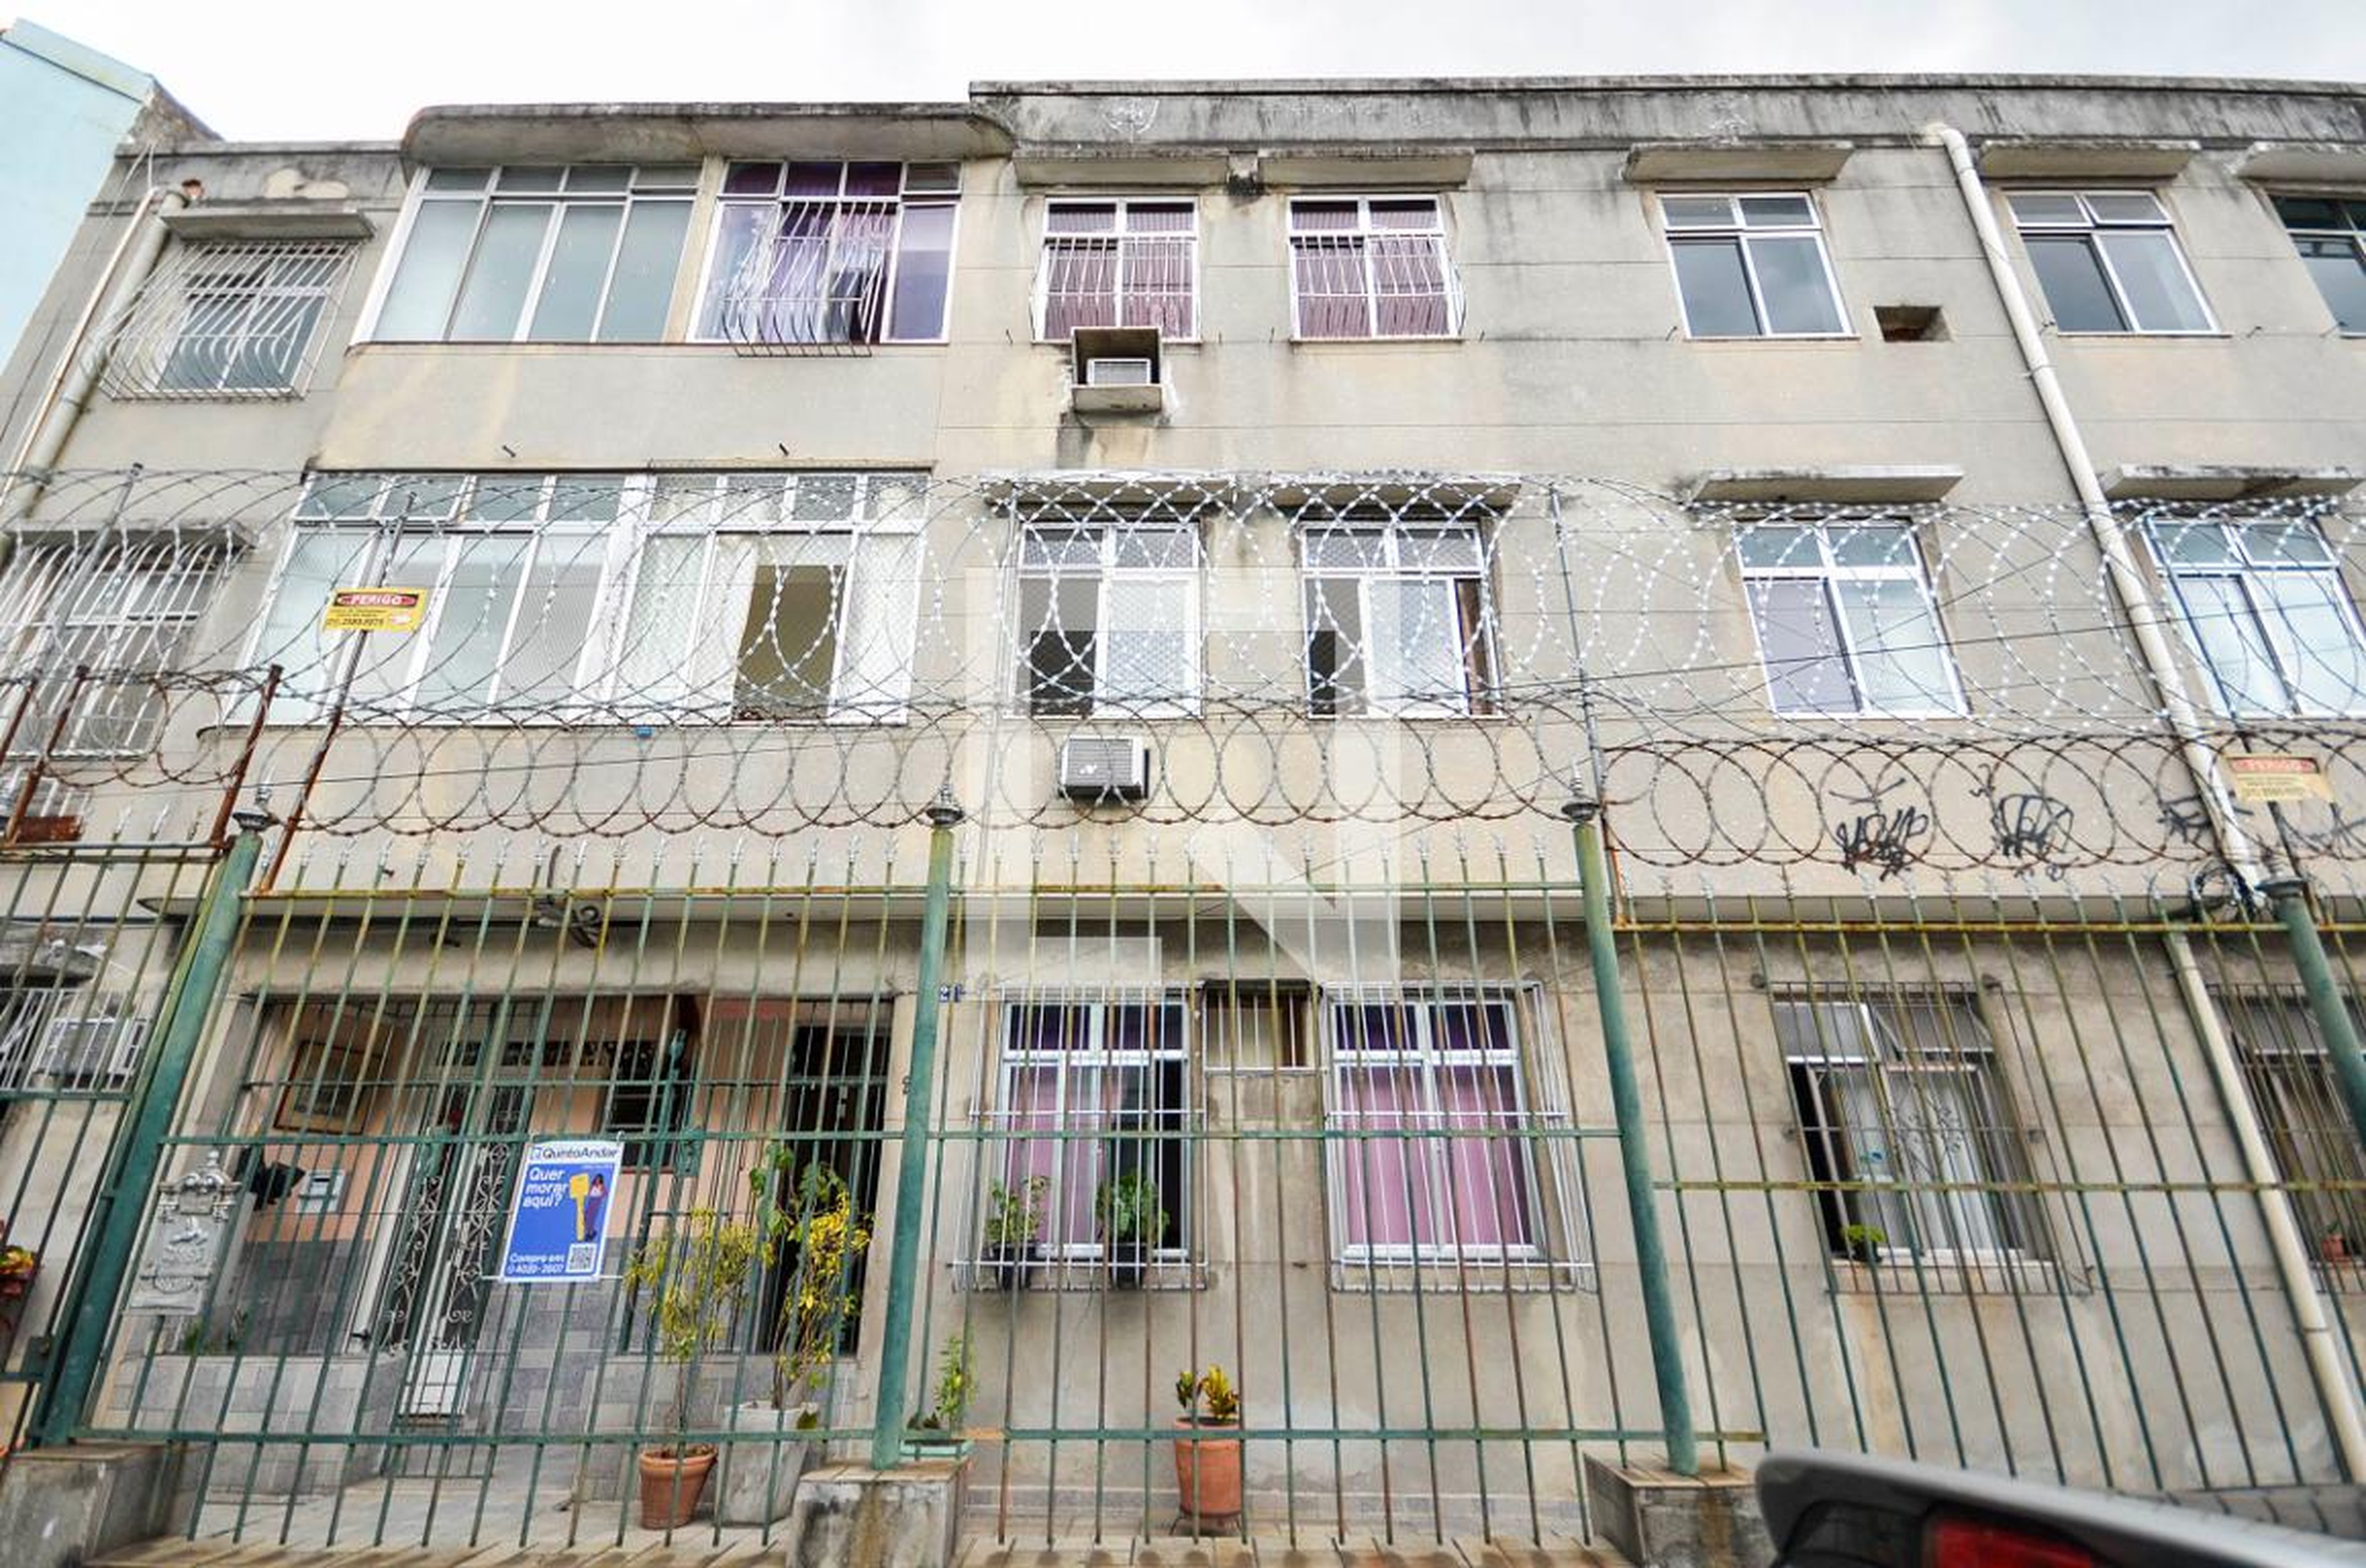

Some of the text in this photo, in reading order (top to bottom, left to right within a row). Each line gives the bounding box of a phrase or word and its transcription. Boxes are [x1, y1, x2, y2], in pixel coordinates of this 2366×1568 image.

[351, 594, 402, 605] PERIGO
[543, 1146, 617, 1160] QuintoAndar
[529, 1167, 565, 1182] Quer
[526, 1182, 569, 1193] morar
[522, 1193, 563, 1209] aqui?
